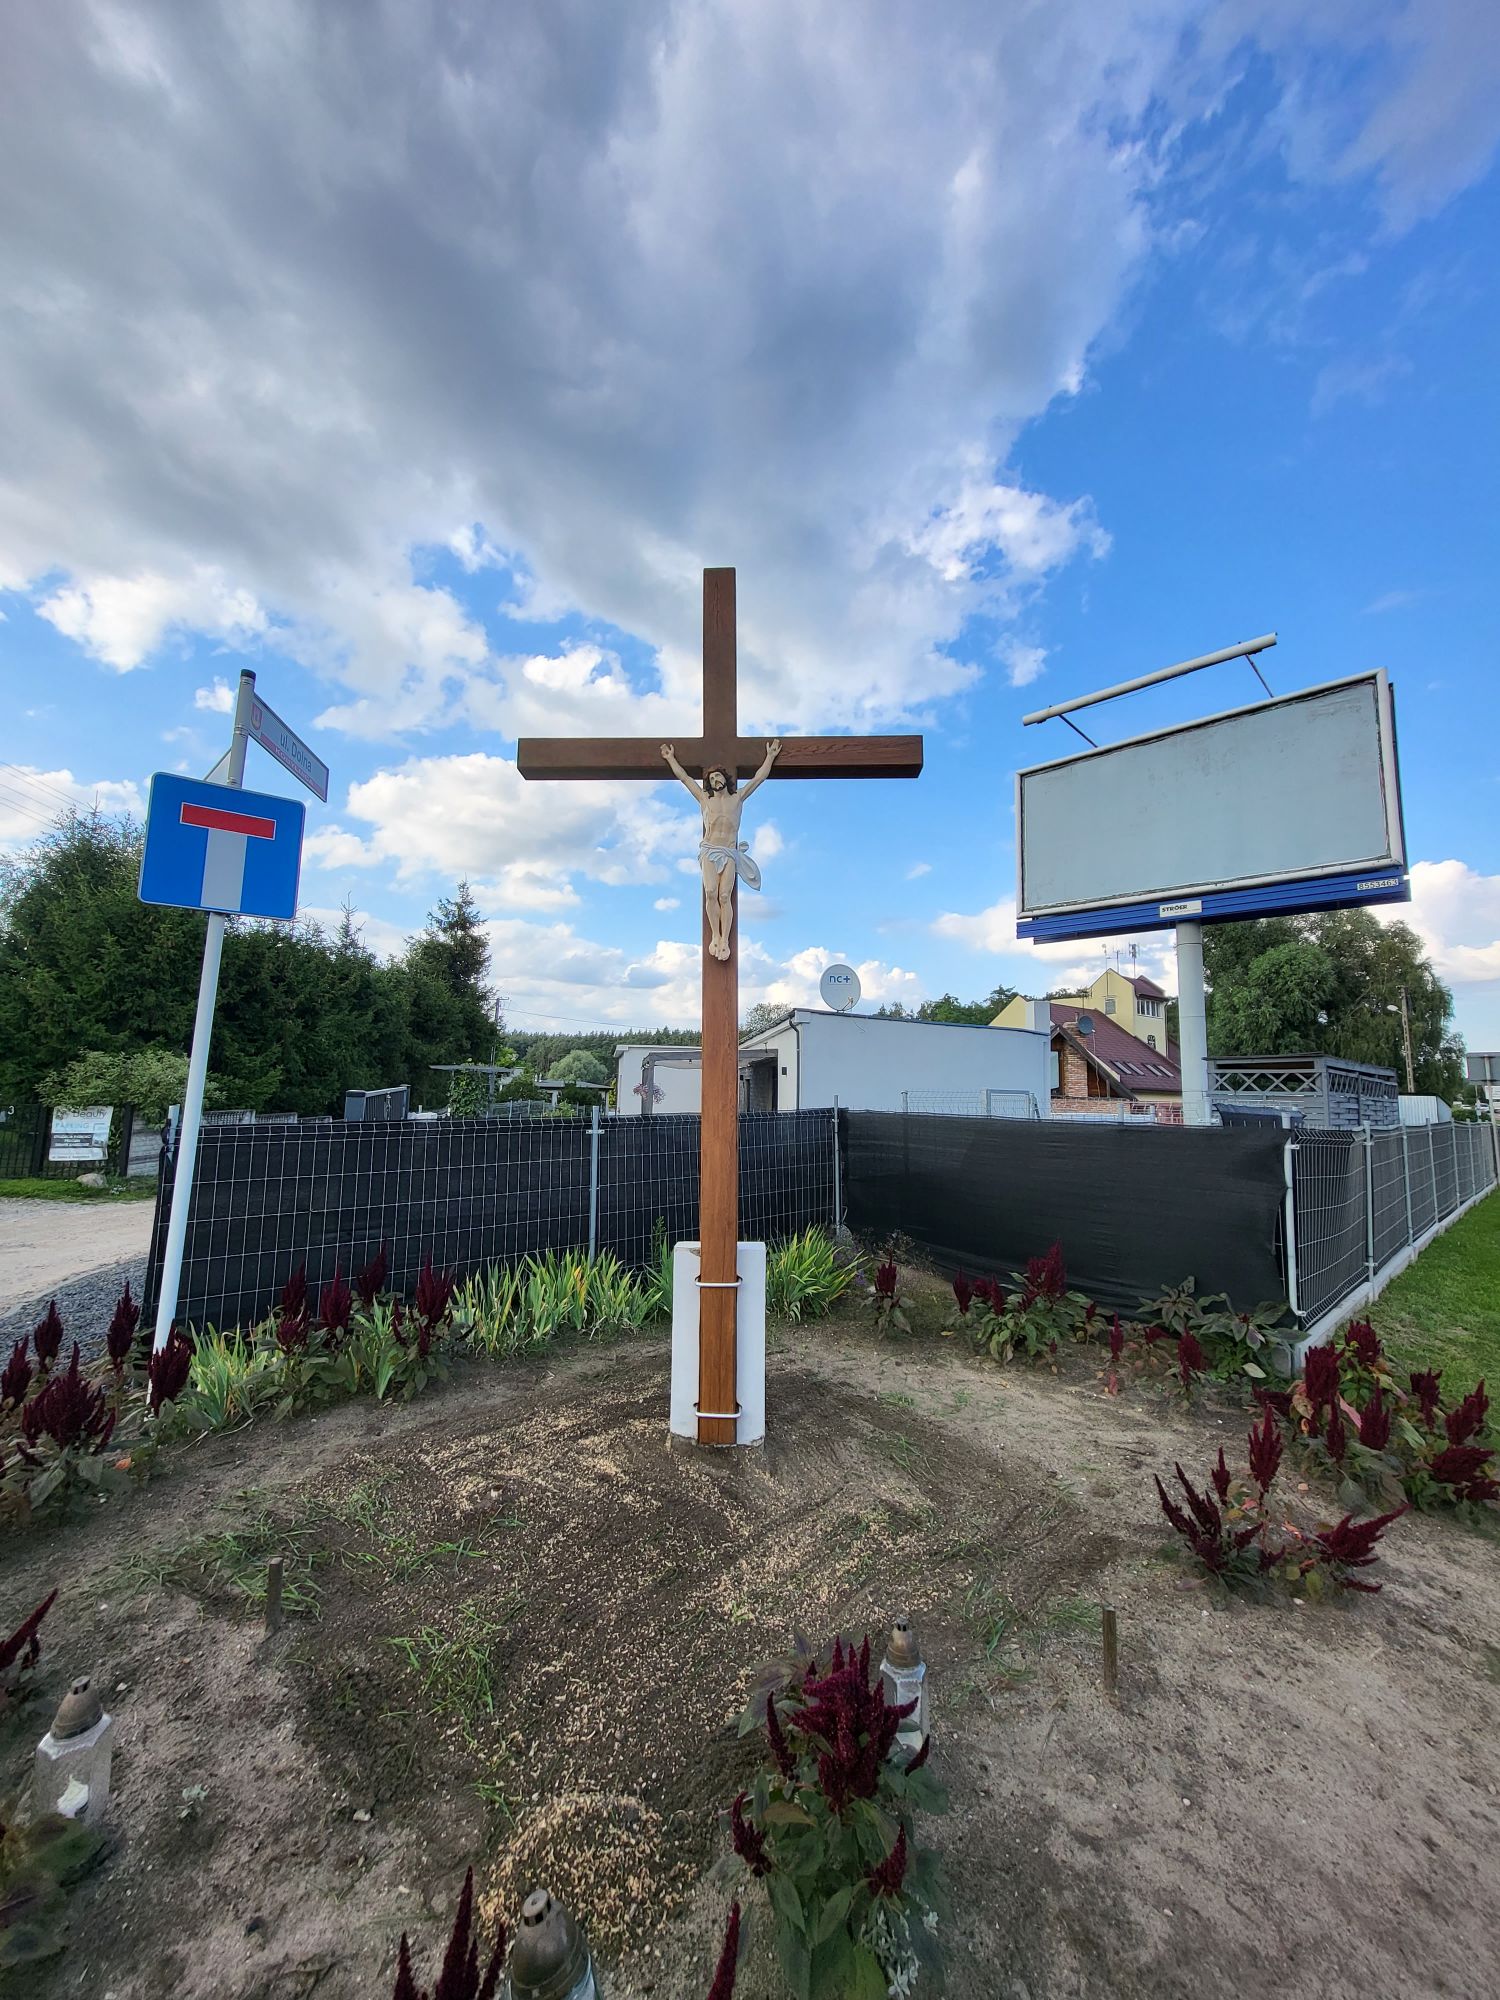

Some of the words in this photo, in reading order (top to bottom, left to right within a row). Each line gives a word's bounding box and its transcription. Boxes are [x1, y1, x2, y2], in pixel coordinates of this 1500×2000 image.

[280, 733, 289, 751] ul.
[291, 741, 312, 773] Dolna
[1358, 879, 1398, 889] 8553463
[829, 975, 850, 983] nc+
[7, 1105, 15, 1115] 3
